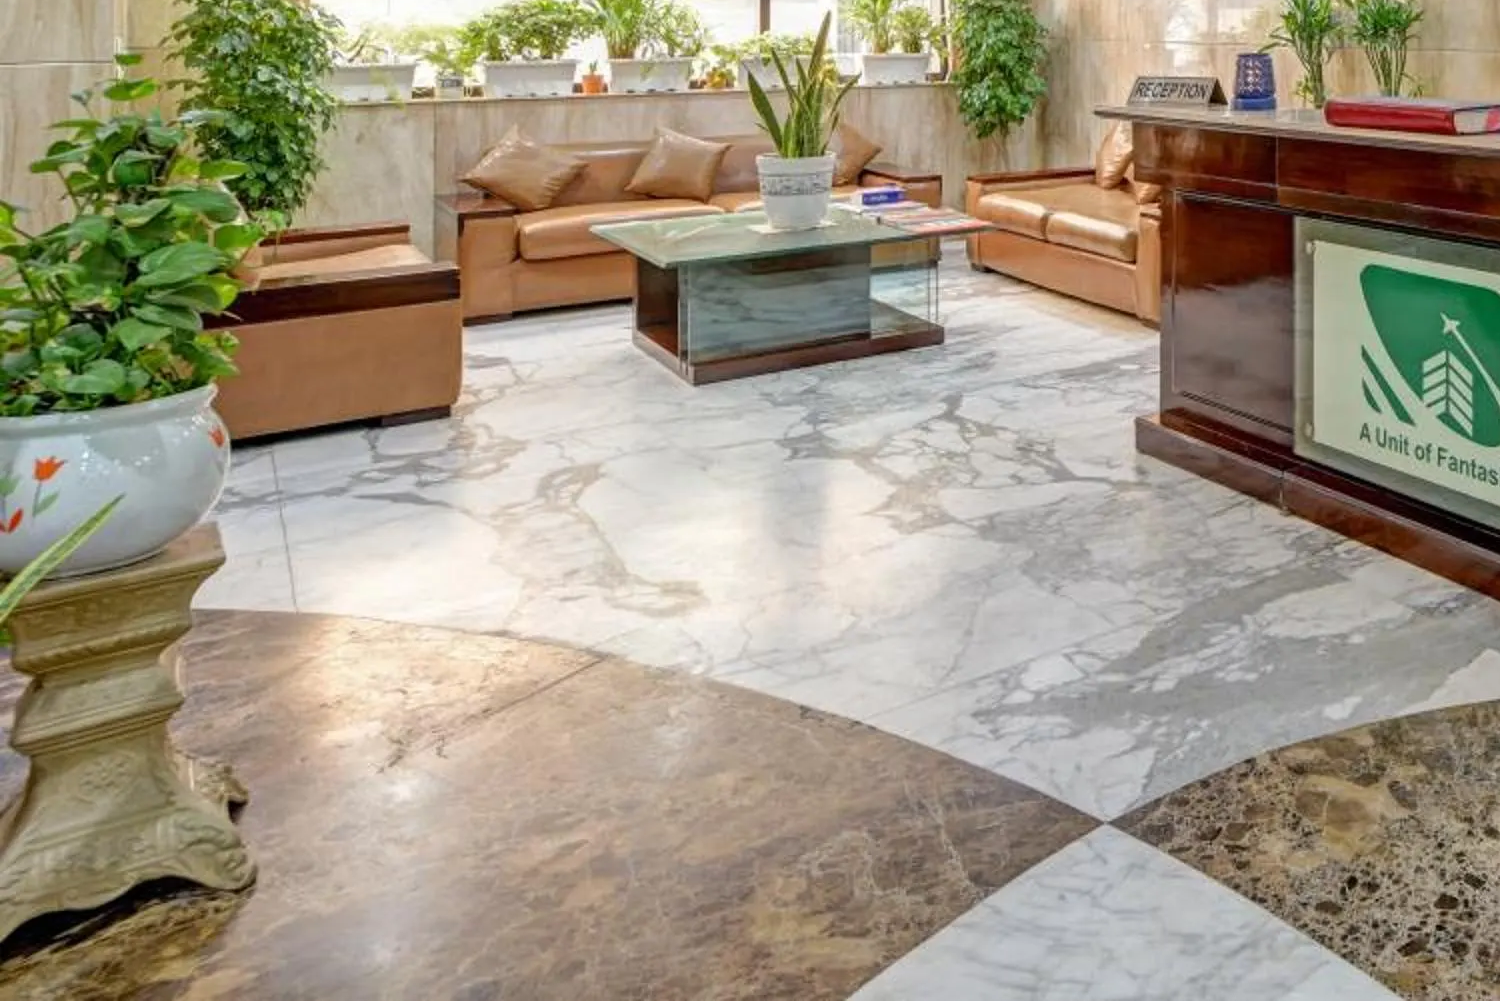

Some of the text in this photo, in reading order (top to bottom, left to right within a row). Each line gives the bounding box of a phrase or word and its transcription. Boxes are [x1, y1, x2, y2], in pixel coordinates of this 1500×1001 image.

[1135, 81, 1210, 100] RECEPTION
[1359, 422, 1371, 444] A
[1376, 428, 1410, 456] Unit
[1415, 442, 1432, 464] of
